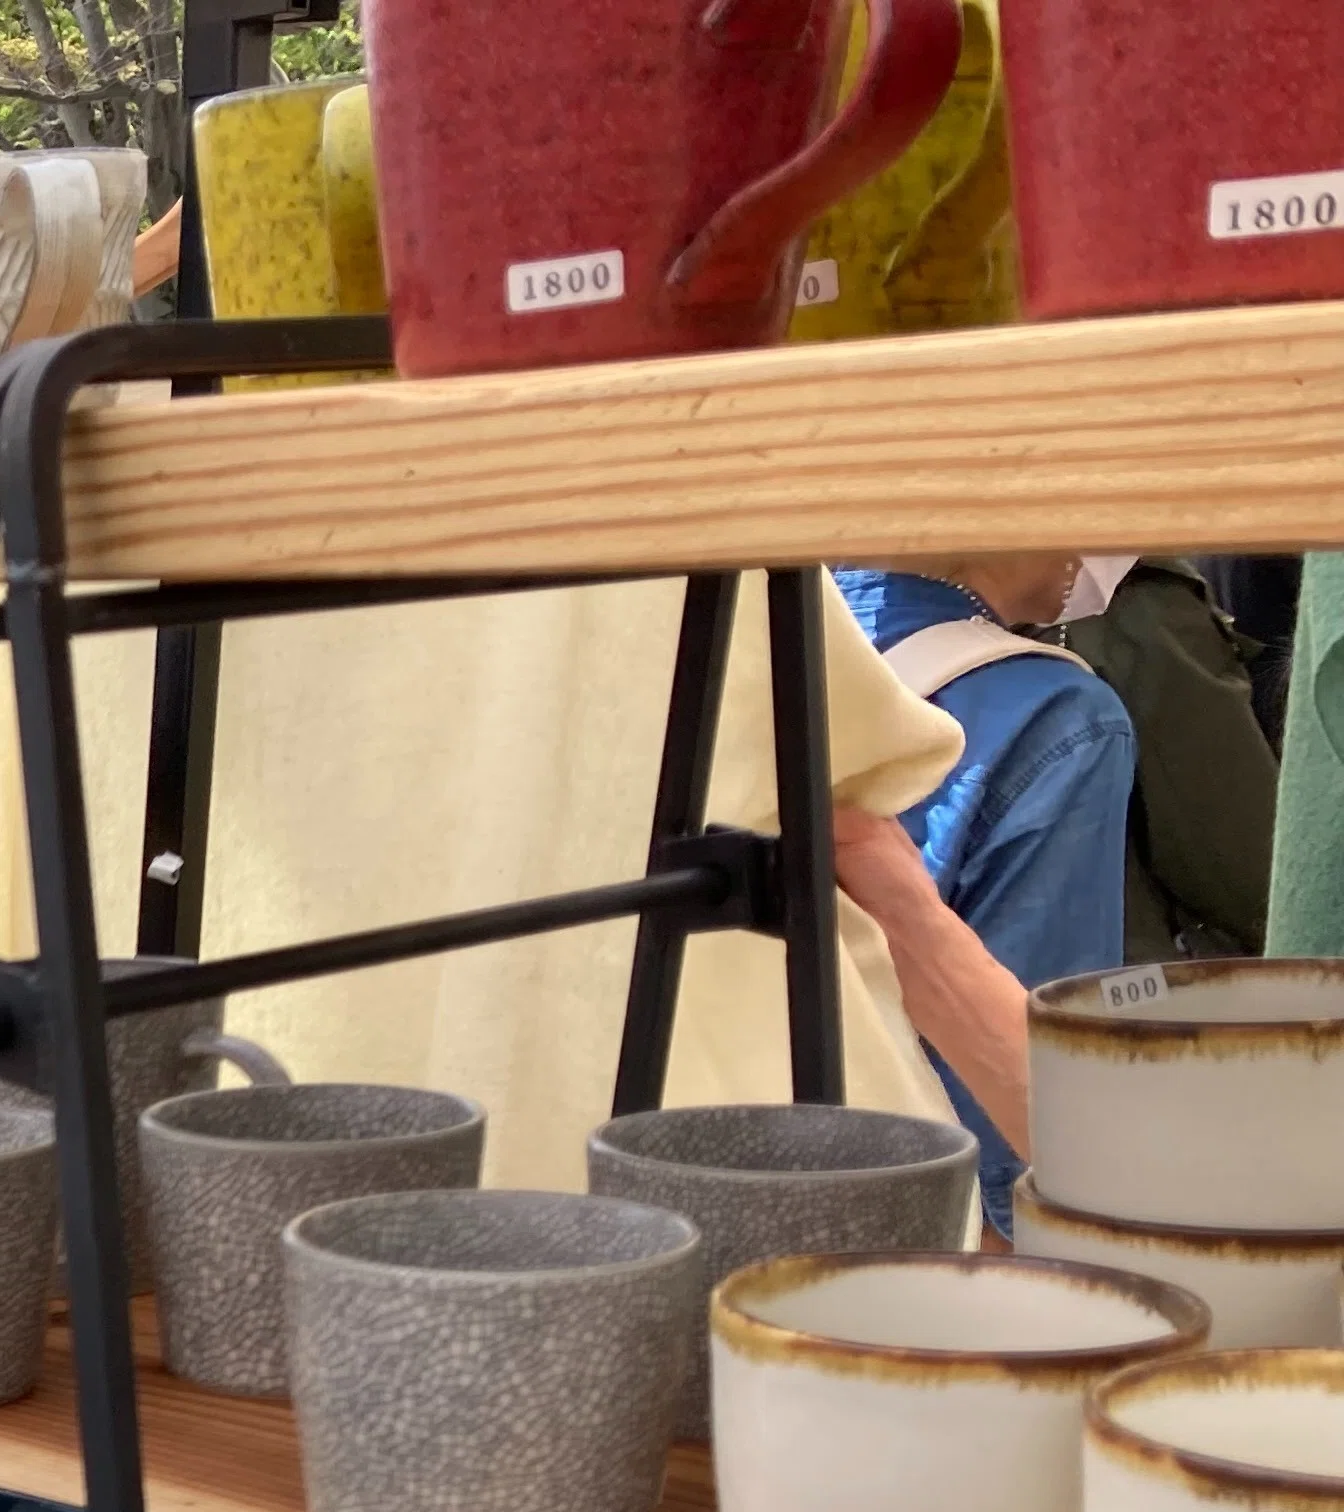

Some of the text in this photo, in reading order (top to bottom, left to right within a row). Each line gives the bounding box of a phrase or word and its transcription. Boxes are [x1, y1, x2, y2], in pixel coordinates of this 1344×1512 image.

[1223, 190, 1340, 231] 1800
[519, 260, 614, 303] 1800
[1108, 975, 1160, 1008] 800
